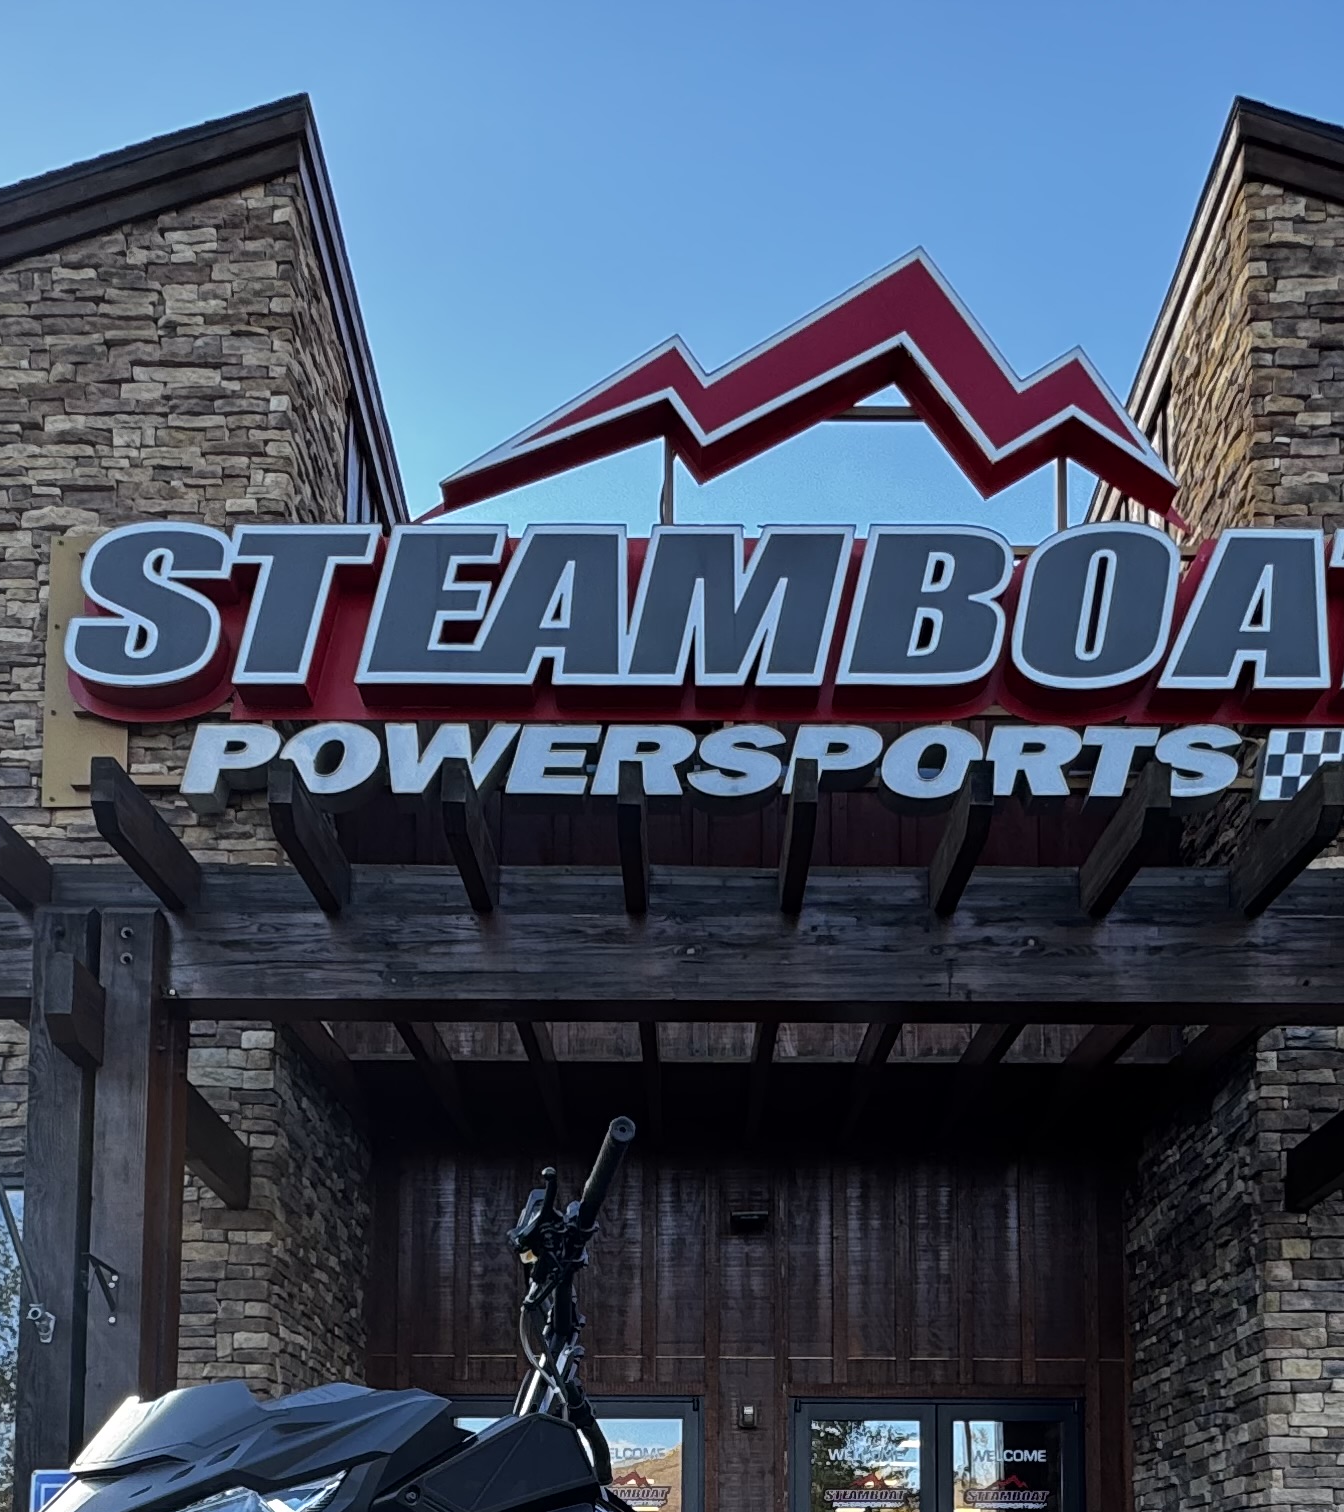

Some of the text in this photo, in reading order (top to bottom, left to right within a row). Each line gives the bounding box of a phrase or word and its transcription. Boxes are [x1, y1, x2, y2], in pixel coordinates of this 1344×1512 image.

[180, 720, 1240, 797] POWERSPORTS
[827, 1449, 905, 1462] WELCOME
[974, 1449, 1047, 1462] WELCOME
[824, 1488, 907, 1502] STEAMBOAT
[966, 1489, 1049, 1502] STEAMBOAT
